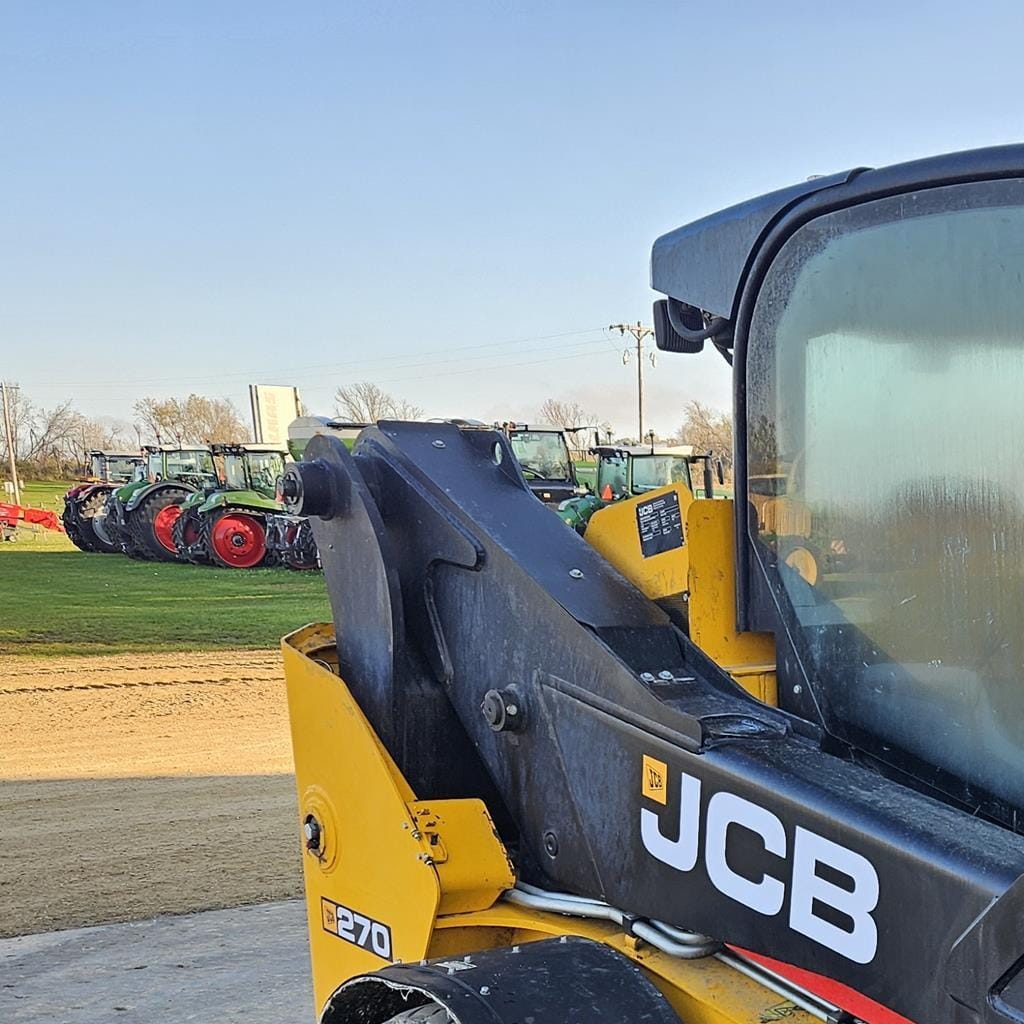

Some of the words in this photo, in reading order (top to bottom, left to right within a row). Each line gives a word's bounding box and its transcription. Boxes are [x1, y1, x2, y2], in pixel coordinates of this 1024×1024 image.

[638, 504, 653, 517] JCB
[648, 768, 663, 788] JCB
[640, 772, 880, 965] JCB
[337, 906, 391, 959] 270
